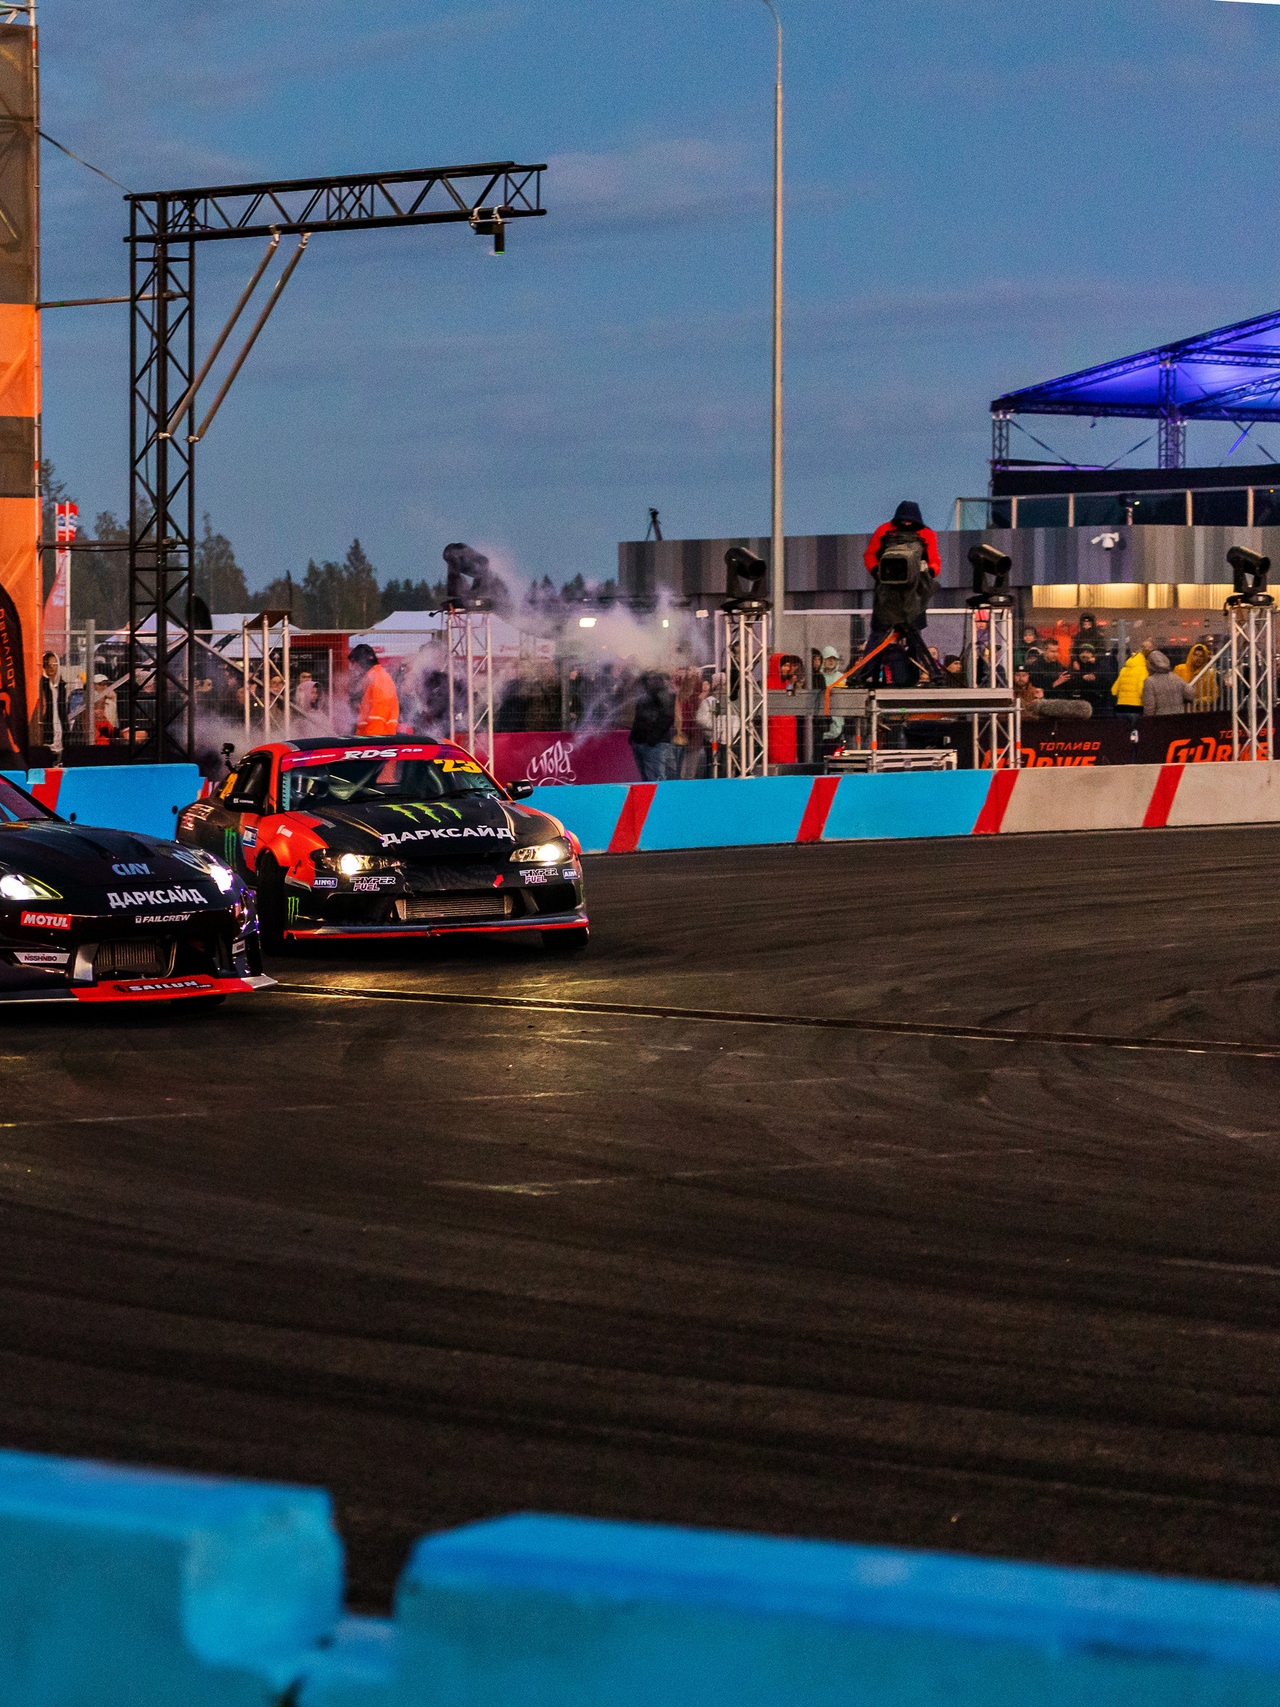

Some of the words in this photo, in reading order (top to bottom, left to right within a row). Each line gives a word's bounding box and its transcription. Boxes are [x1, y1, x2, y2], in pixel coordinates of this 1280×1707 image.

[1040, 742, 1101, 752] ТОПЛИВО
[341, 748, 399, 760] RDS
[433, 759, 483, 775] 23
[380, 824, 516, 848] ДАРКСАЙД
[352, 882, 381, 892] FUEL
[106, 885, 209, 910] ДАРКСАЙД
[23, 913, 69, 928] MOTUL
[142, 914, 192, 923] FAILCREW
[129, 980, 198, 992] SAILUN
